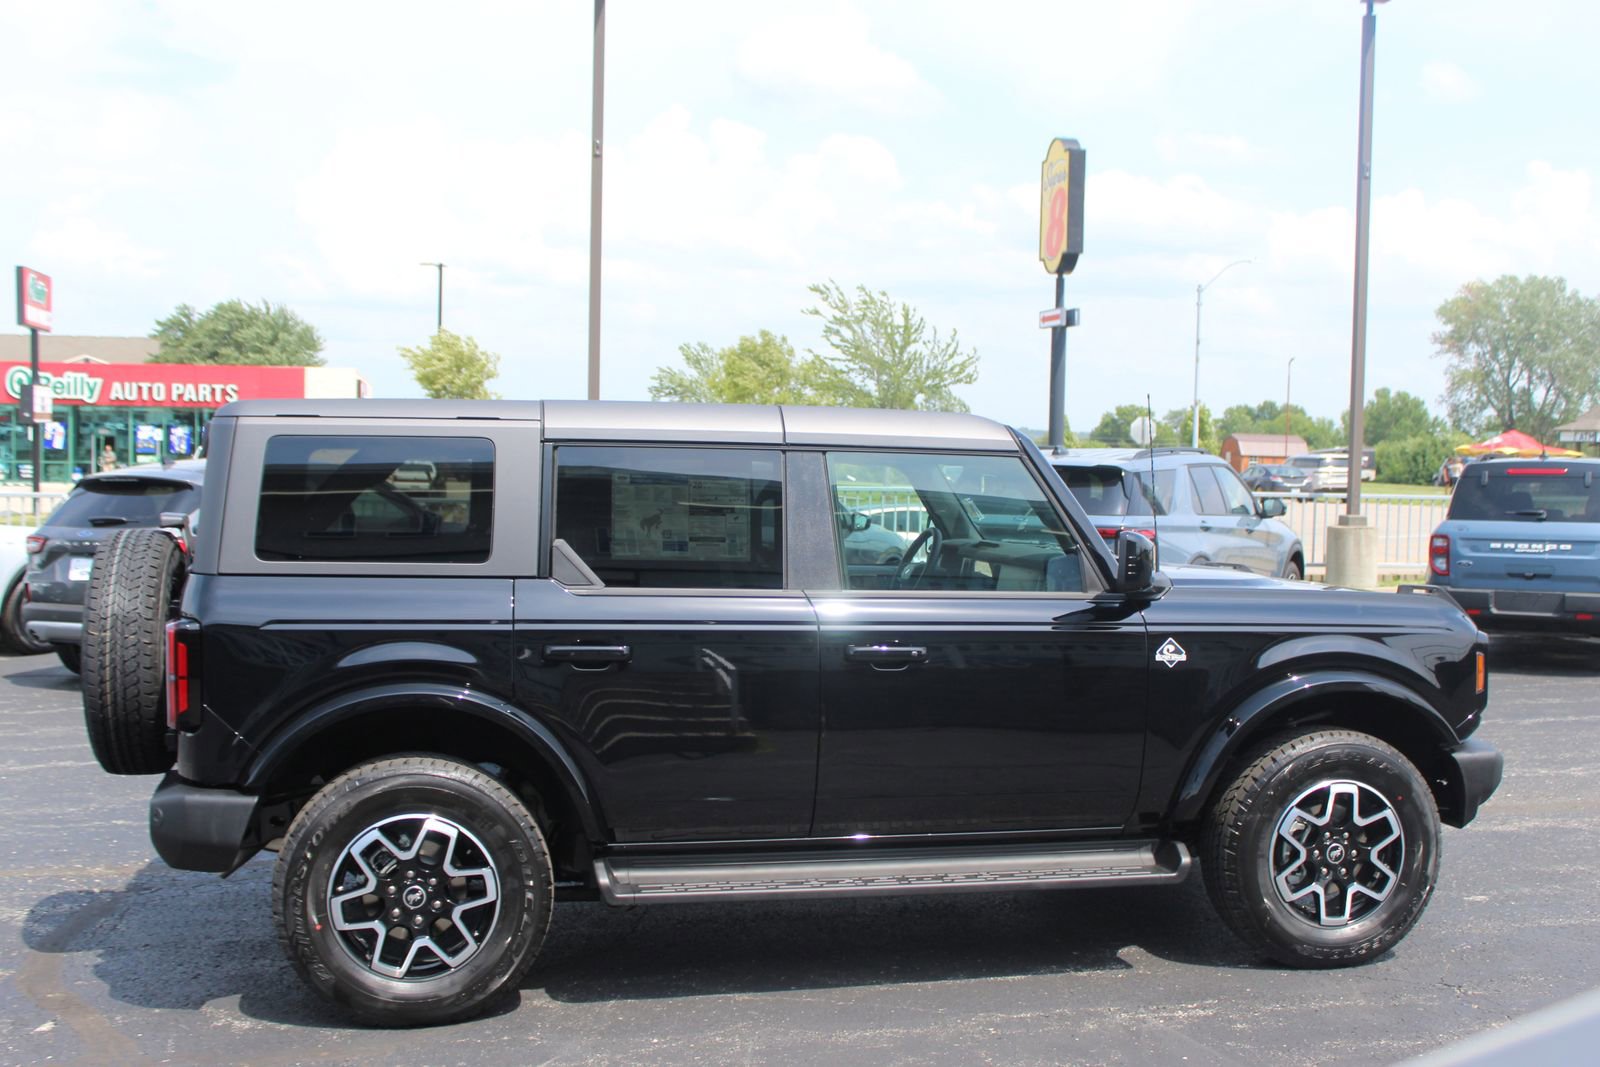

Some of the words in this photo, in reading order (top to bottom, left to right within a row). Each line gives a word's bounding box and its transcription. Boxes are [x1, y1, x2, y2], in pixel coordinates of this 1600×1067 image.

[1046, 187, 1066, 259] 8
[6, 366, 103, 403] Oeilly
[109, 382, 166, 402] AUTO
[171, 383, 239, 402] PARTS
